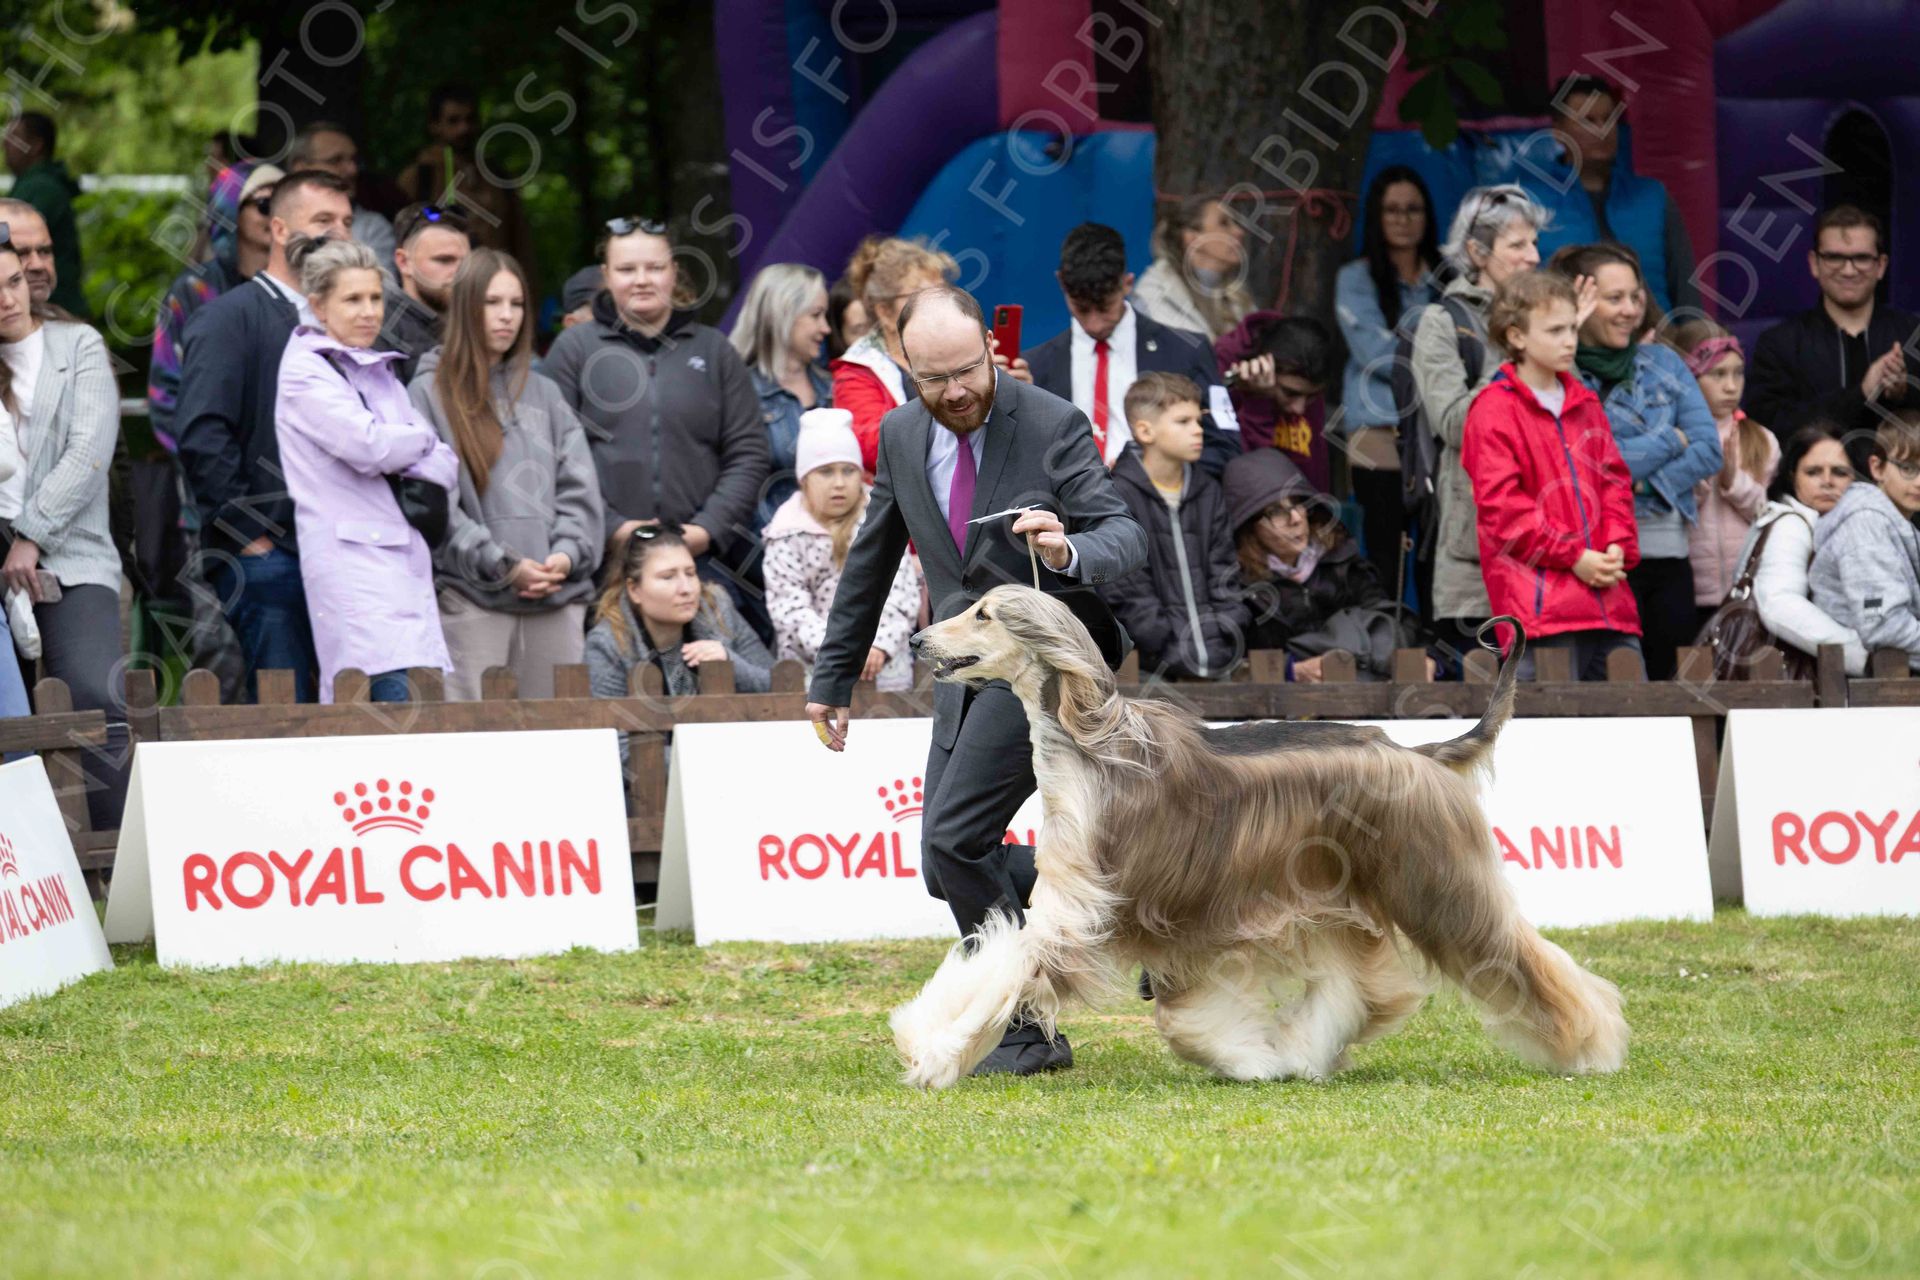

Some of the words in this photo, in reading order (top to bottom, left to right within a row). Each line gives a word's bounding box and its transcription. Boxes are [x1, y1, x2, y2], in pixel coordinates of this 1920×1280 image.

[183, 847, 385, 912] ROYAL
[399, 838, 602, 902] CANIN
[758, 831, 917, 881] ROYAL
[20, 873, 76, 932] CANIN
